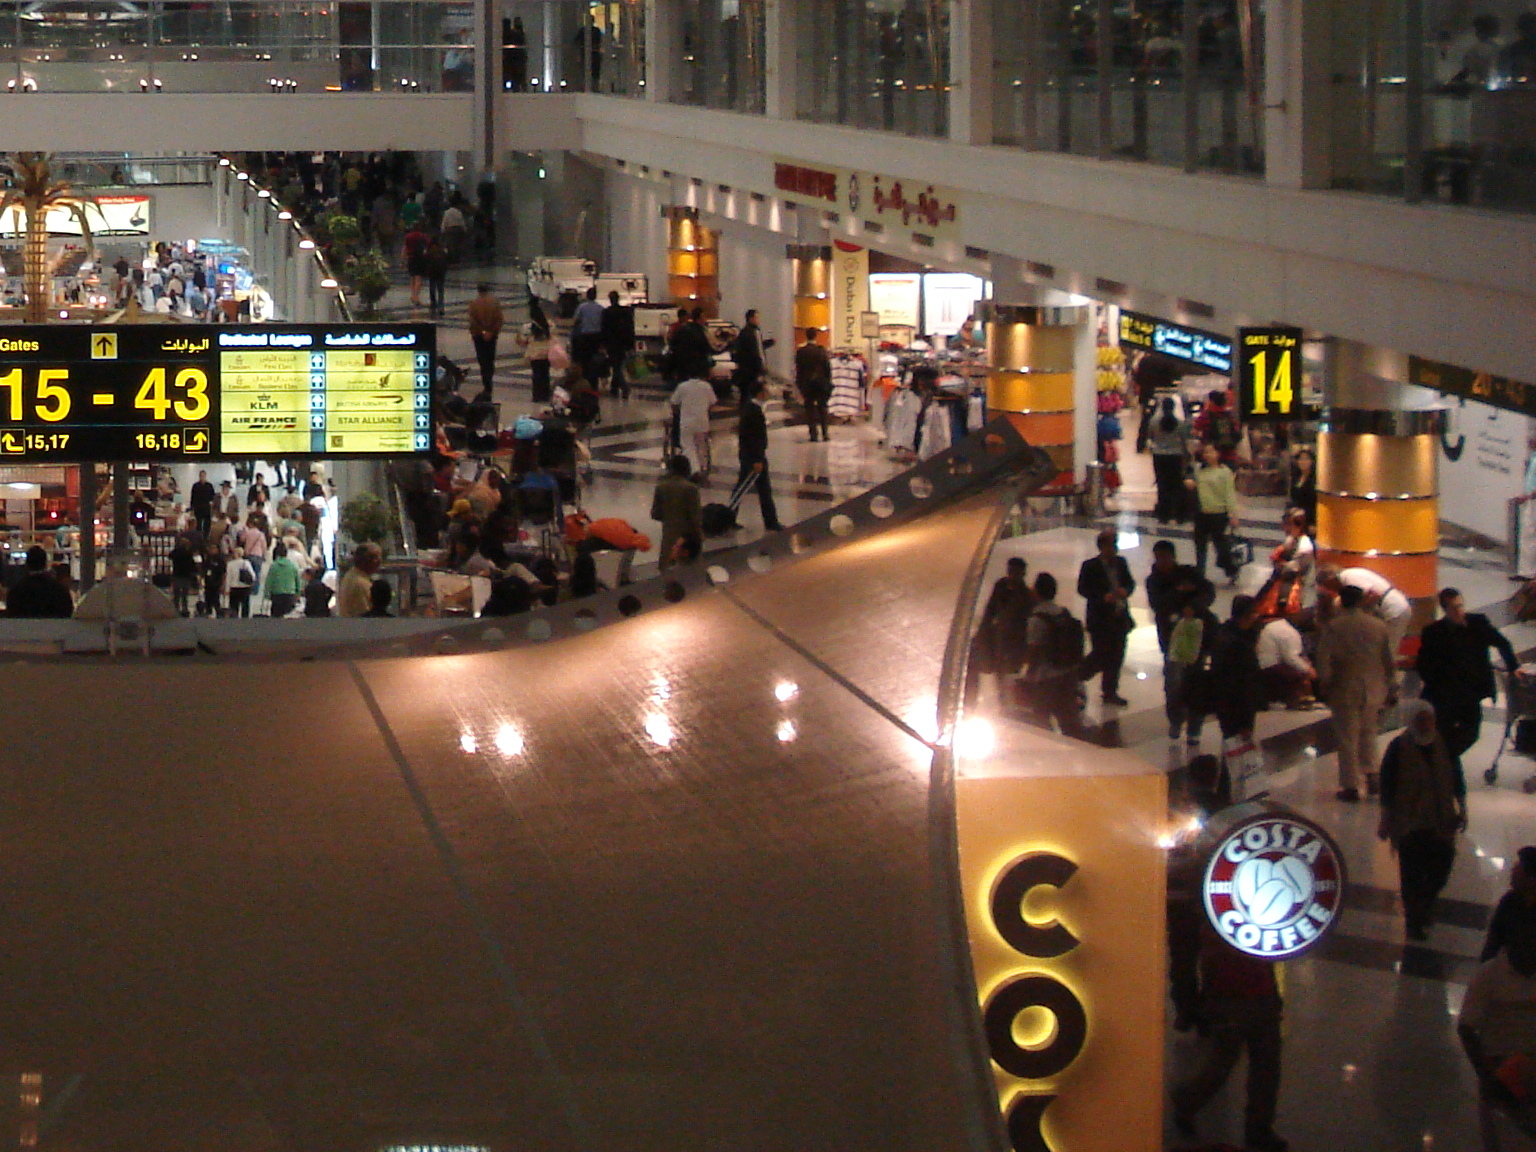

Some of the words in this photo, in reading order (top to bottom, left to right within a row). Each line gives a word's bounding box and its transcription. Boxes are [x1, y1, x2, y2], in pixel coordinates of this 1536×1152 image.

[161, 338, 209, 354] البوابات
[92, 393, 115, 405] -
[134, 367, 210, 421] 43
[1249, 350, 1294, 415] 14
[250, 402, 278, 410] KLM
[25, 434, 70, 452] 15,17
[135, 433, 180, 451] 16,18
[1224, 823, 1322, 864] COSTA
[1220, 903, 1332, 951] COFFEE
